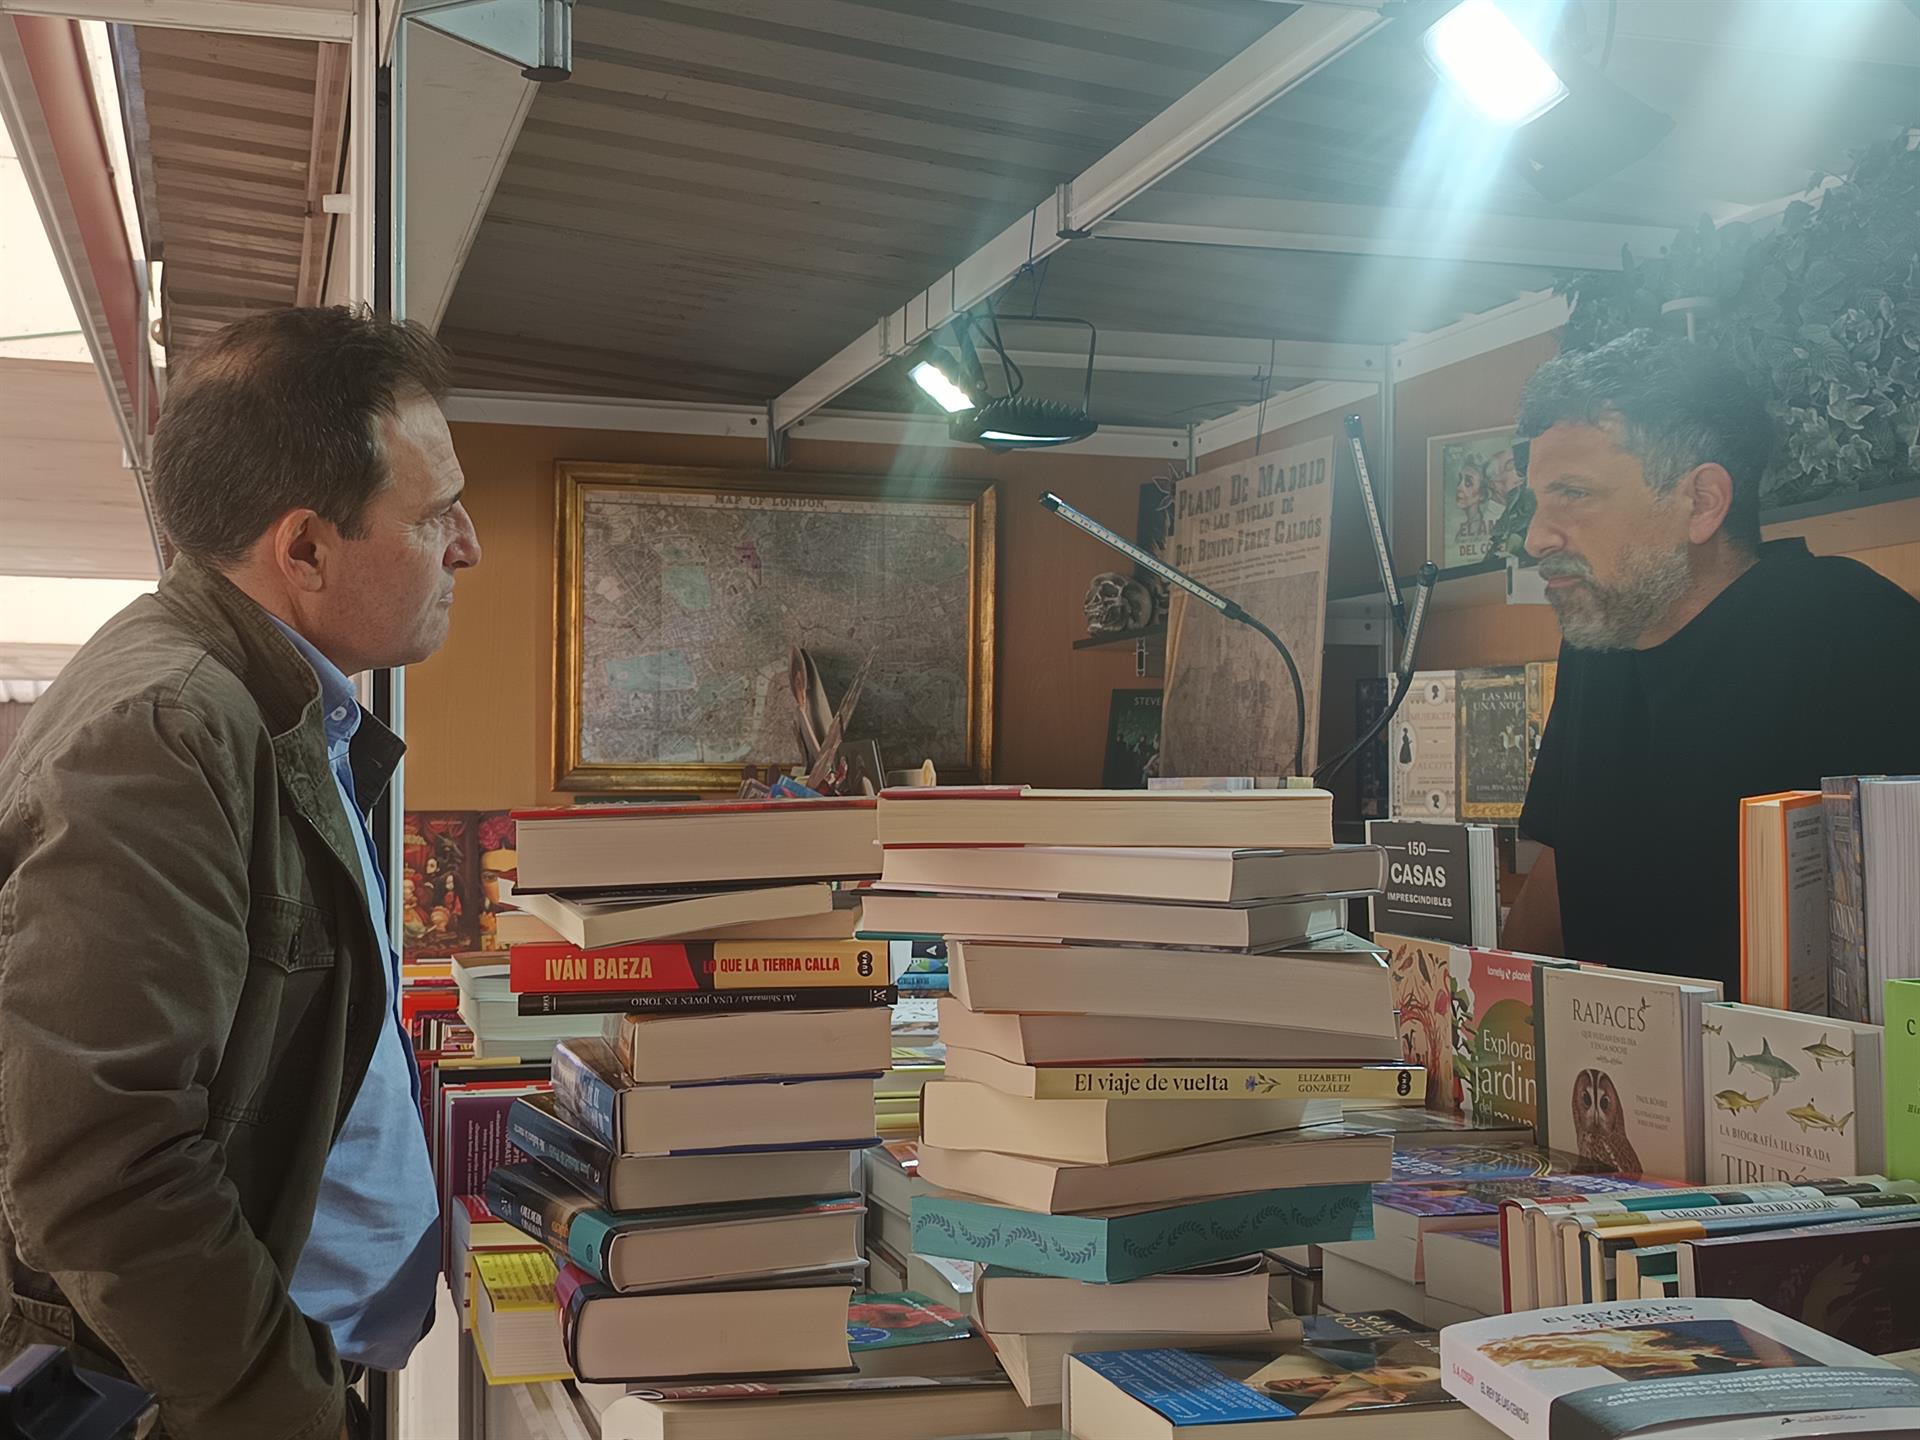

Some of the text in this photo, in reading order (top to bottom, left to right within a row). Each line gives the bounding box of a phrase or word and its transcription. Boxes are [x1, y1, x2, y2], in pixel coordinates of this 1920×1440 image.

[1257, 458, 1326, 498] MADRID
[714, 494, 742, 505] MAP
[750, 496, 765, 506] OF
[1213, 513, 1230, 531] LAS
[1407, 841, 1426, 857] 150
[1390, 862, 1447, 888] CASAS
[1387, 891, 1452, 908] IMPRESCINDIBLES
[545, 954, 653, 981] IVÁN BAEZA
[703, 956, 840, 974] LO QUE LA TIERRA CALLA
[861, 953, 869, 975] SUMA
[1487, 966, 1505, 980] lonely
[631, 996, 662, 1007] TOKIO
[665, 996, 678, 1006] EN
[680, 994, 711, 1006] JOVEN
[712, 995, 733, 1004] UNA
[1572, 998, 1646, 1032] RAPACES
[1074, 1071, 1229, 1096] El viaje de vuelta
[1297, 1073, 1351, 1083] ELIZABETH
[1297, 1081, 1350, 1093] GONZÁLEZ
[1479, 1098, 1493, 1114] del
[1720, 1124, 1831, 1163] LA BIOGRAFÍA ILUSTRADA
[1660, 1205, 1727, 1219] Cuando
[1729, 1204, 1746, 1216] el
[1748, 1200, 1794, 1214] viento
[1542, 1304, 1694, 1324] EL REY DE LAS
